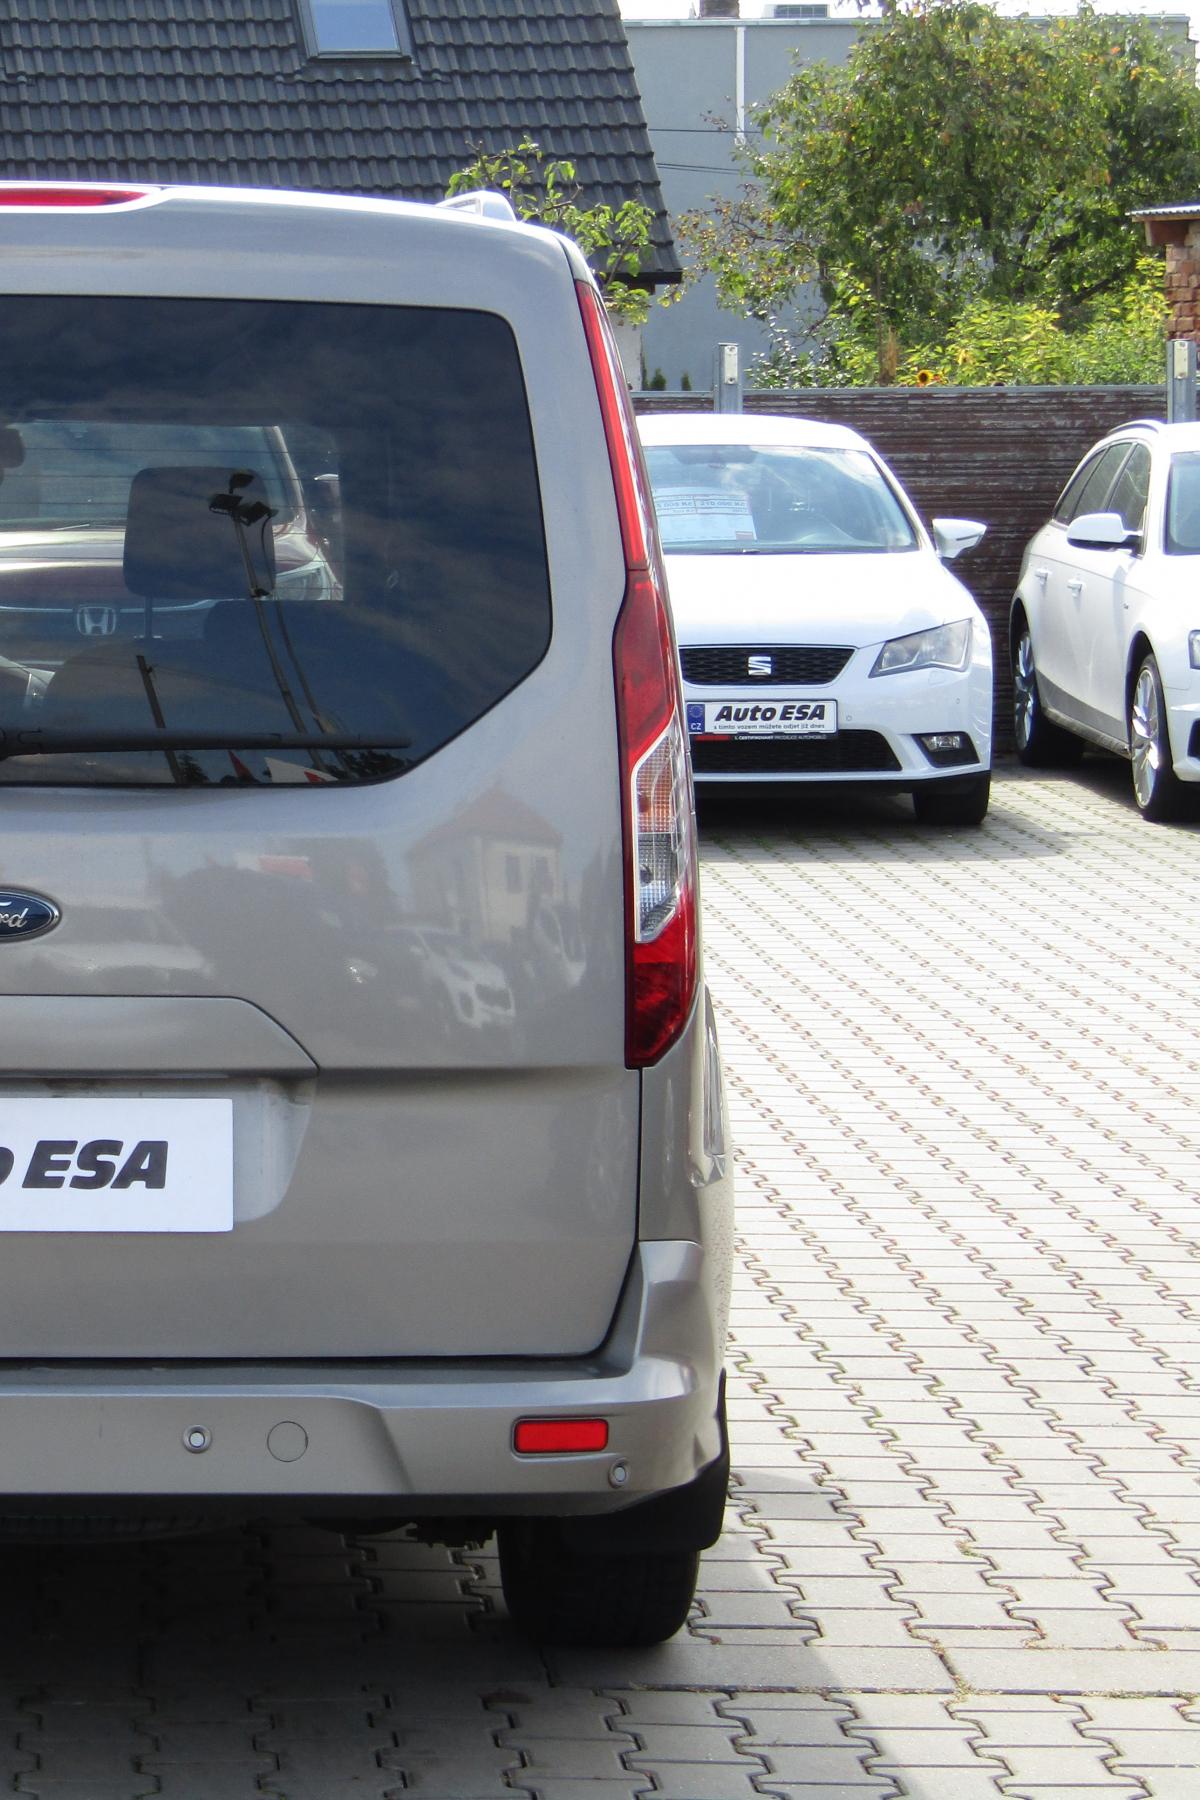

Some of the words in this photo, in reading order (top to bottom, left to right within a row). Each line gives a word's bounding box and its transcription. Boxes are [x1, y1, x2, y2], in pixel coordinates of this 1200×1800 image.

[714, 704, 777, 722] Auto
[779, 704, 826, 721] ESA
[690, 722, 702, 731] CZ
[21, 1140, 169, 1189] ESA
